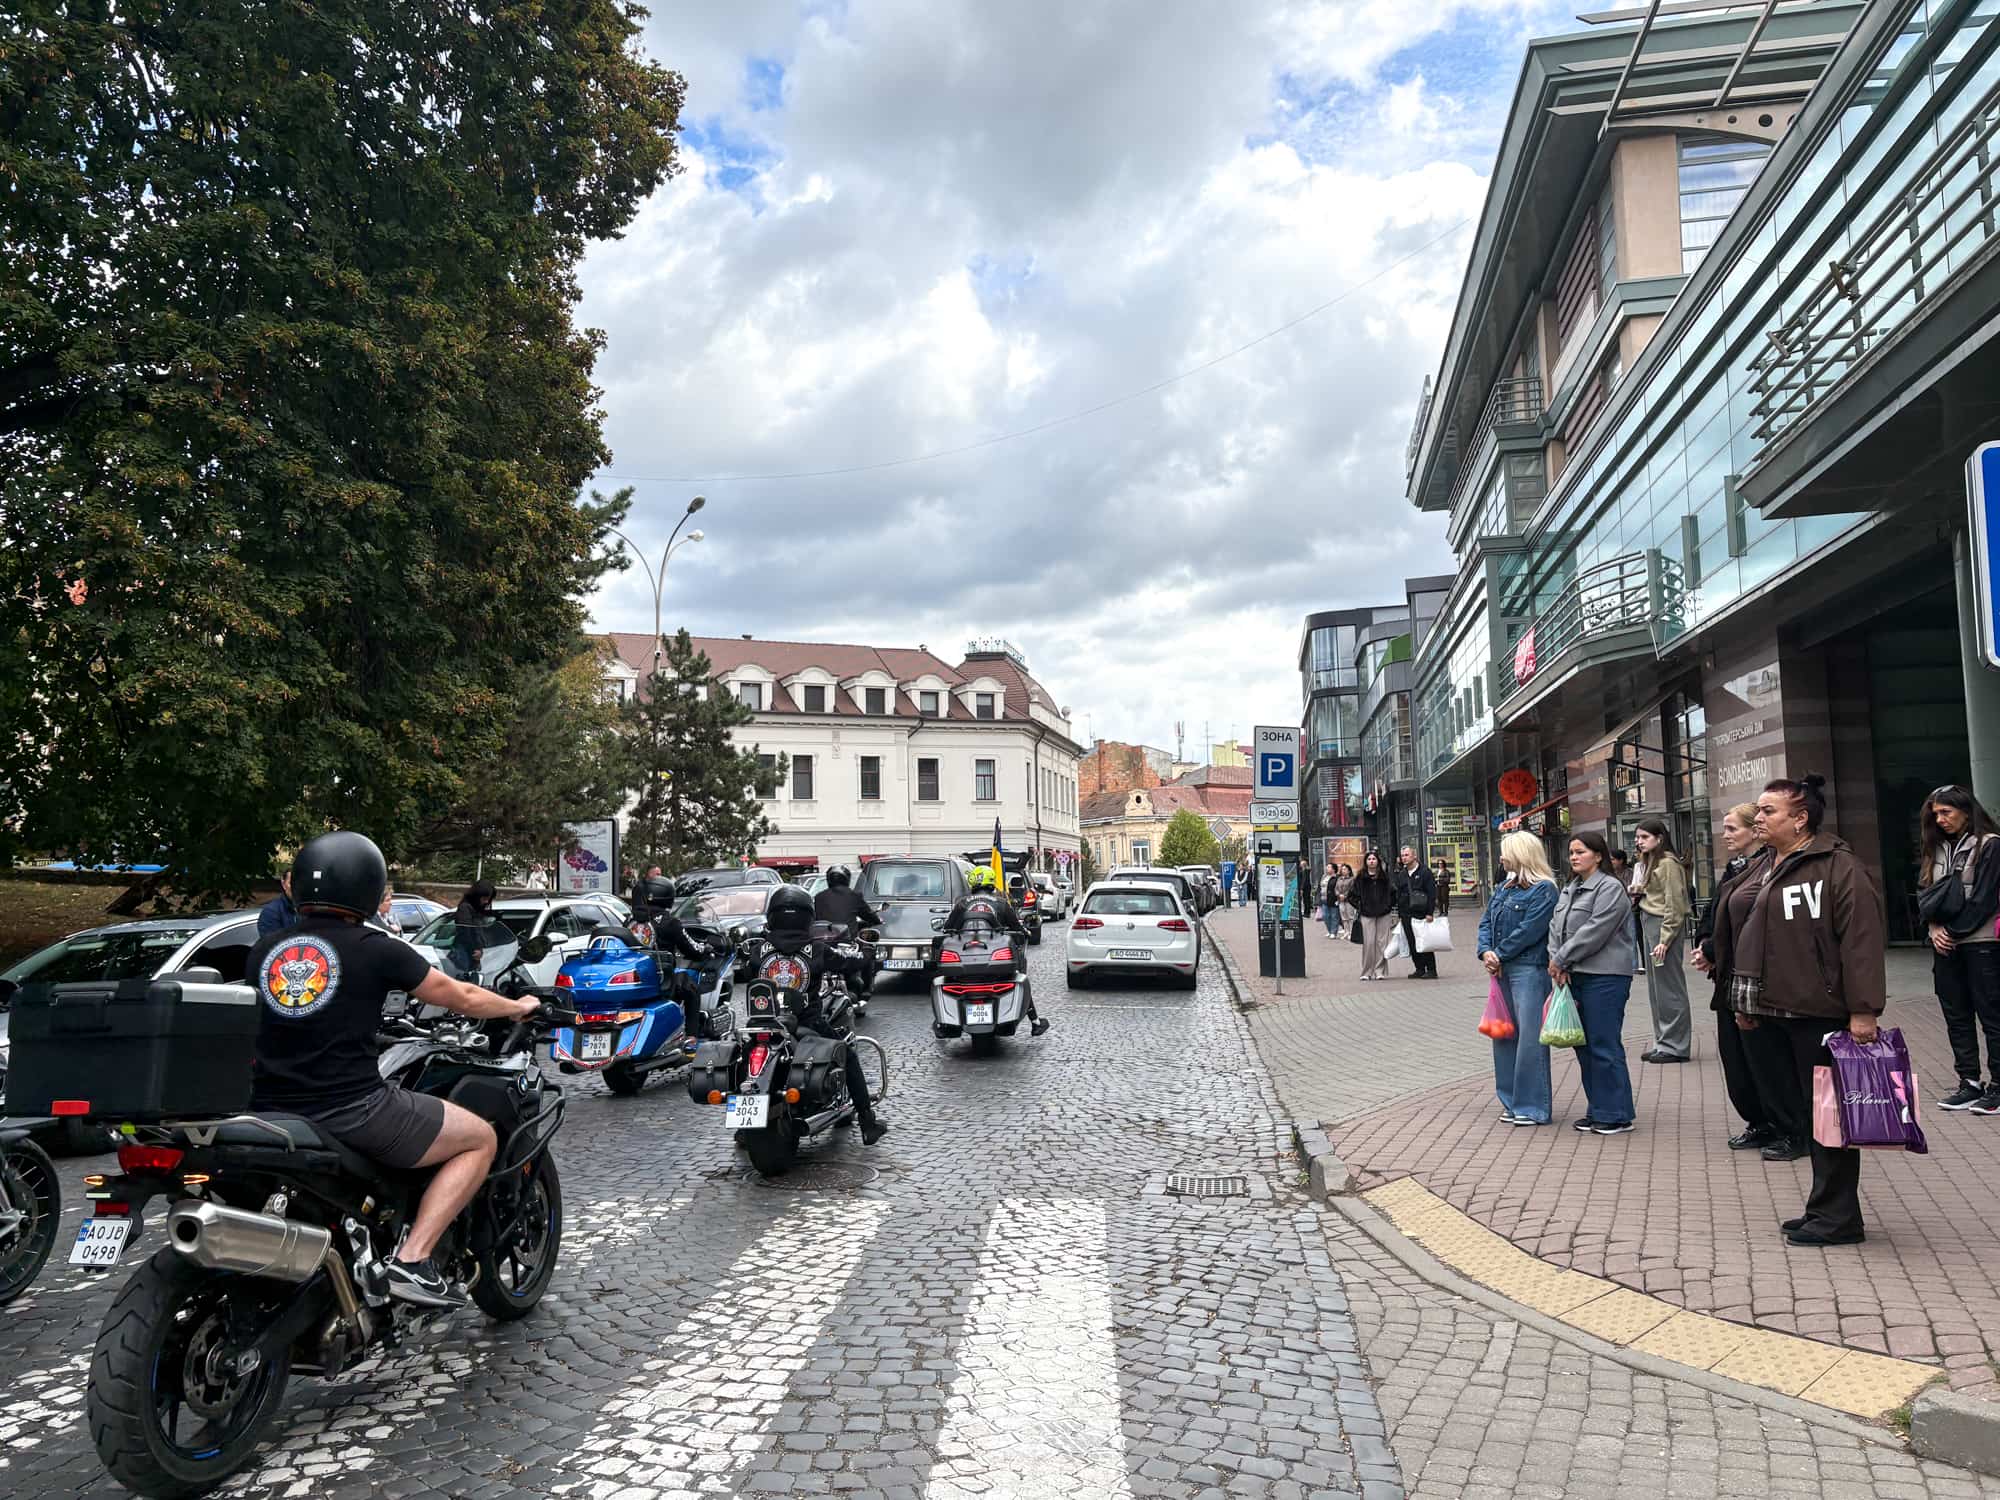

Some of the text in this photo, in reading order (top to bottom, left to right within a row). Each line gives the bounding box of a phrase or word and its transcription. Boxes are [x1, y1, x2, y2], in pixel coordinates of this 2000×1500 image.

[1262, 731, 1293, 742] ЗОНА
[1268, 758, 1286, 782] P
[1719, 758, 1767, 787] BONDARENKO
[1280, 809, 1290, 817] 50
[1782, 880, 1823, 920] FV
[741, 1097, 755, 1106] AO
[736, 1107, 758, 1116] 3043
[740, 1117, 752, 1126] JA
[82, 1245, 116, 1260] 0498
